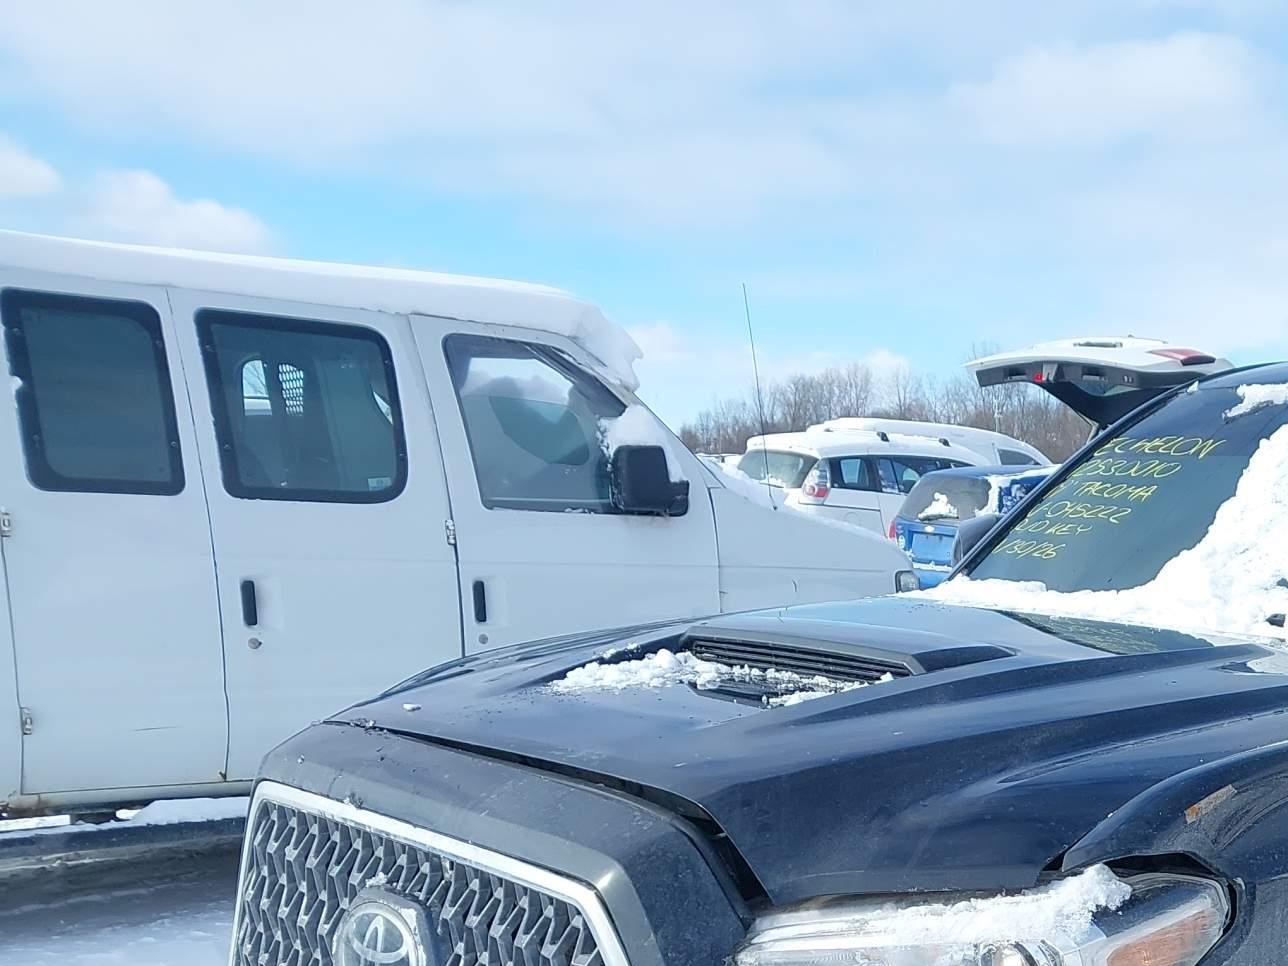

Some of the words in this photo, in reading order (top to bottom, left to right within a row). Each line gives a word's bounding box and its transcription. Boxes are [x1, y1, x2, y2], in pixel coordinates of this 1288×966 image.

[1094, 434, 1227, 459] ECHELON
[1073, 481, 1159, 501] TACOMA
[1044, 522, 1093, 536] KEY
